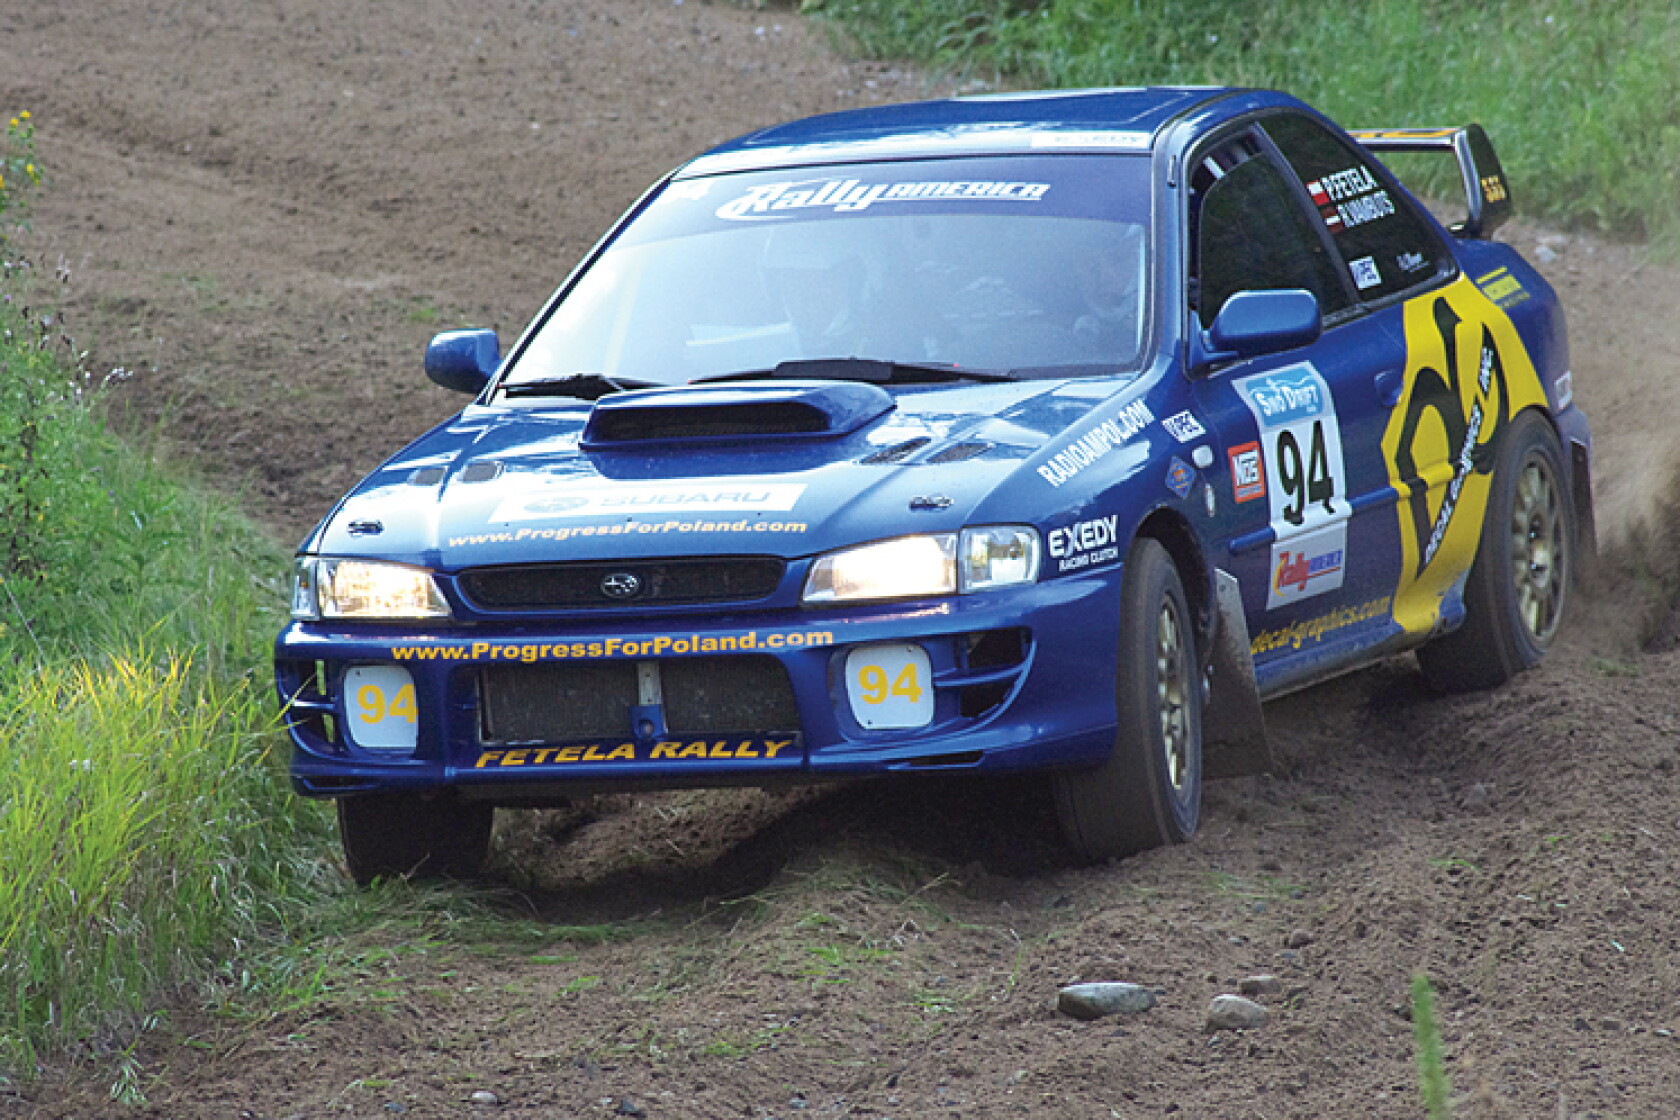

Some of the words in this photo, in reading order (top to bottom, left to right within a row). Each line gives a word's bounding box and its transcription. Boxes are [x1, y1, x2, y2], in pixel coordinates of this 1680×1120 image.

[715, 177, 884, 220] Rally
[1277, 420, 1335, 526] 94
[600, 492, 772, 506] SUBARU
[449, 520, 807, 547] www.ProgressForPoland.com
[1049, 515, 1118, 556] EXEDY
[391, 631, 833, 663] www.ProgressForPoland.com
[858, 662, 922, 705] 94
[357, 684, 417, 724] 94
[475, 743, 635, 768] FETELA
[648, 738, 792, 759] RALLY
